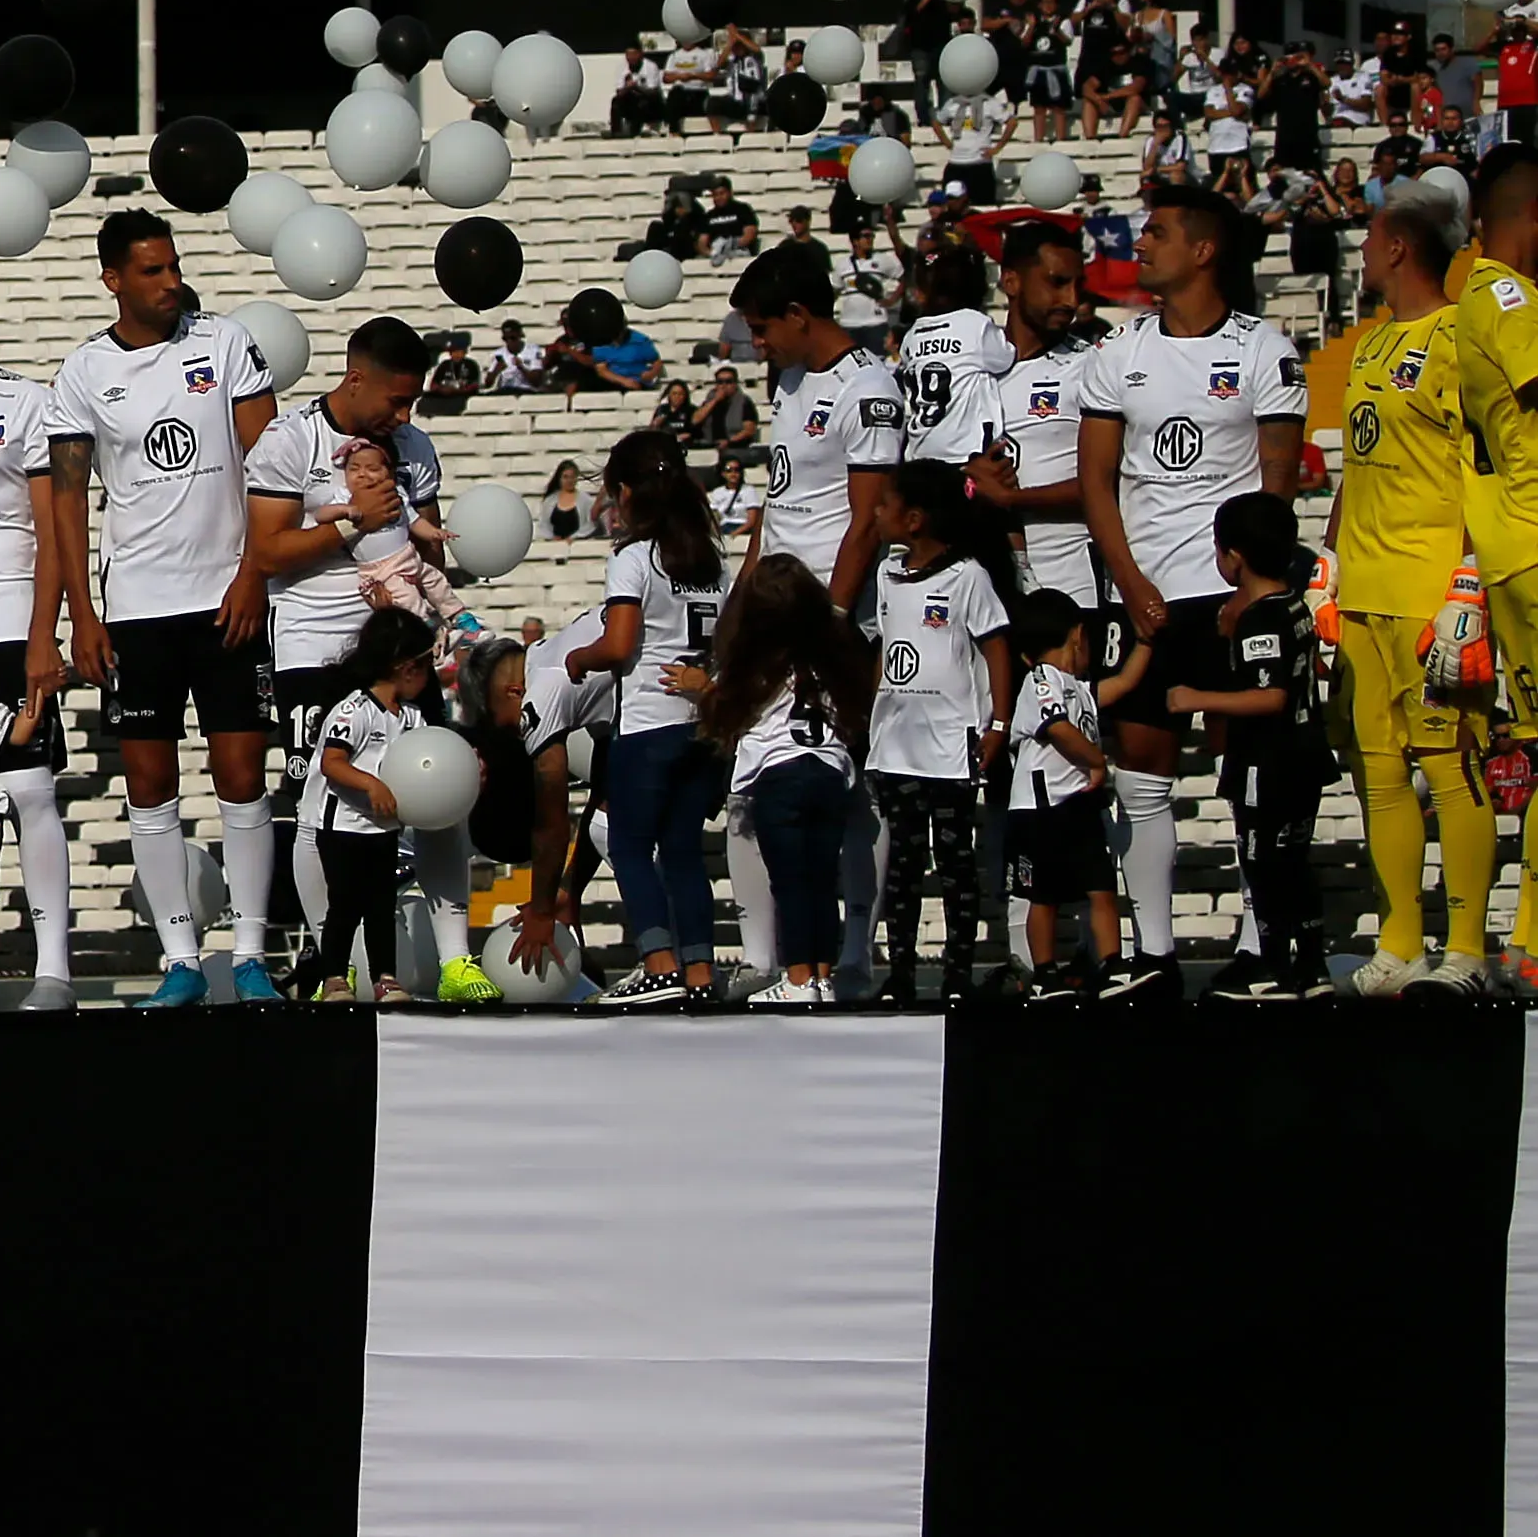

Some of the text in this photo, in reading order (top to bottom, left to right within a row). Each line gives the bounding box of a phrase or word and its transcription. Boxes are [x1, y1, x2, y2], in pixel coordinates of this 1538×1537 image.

[915, 338, 962, 356] JESUS
[150, 424, 190, 466] MG
[1158, 423, 1197, 465] MG
[886, 645, 915, 681] MG
